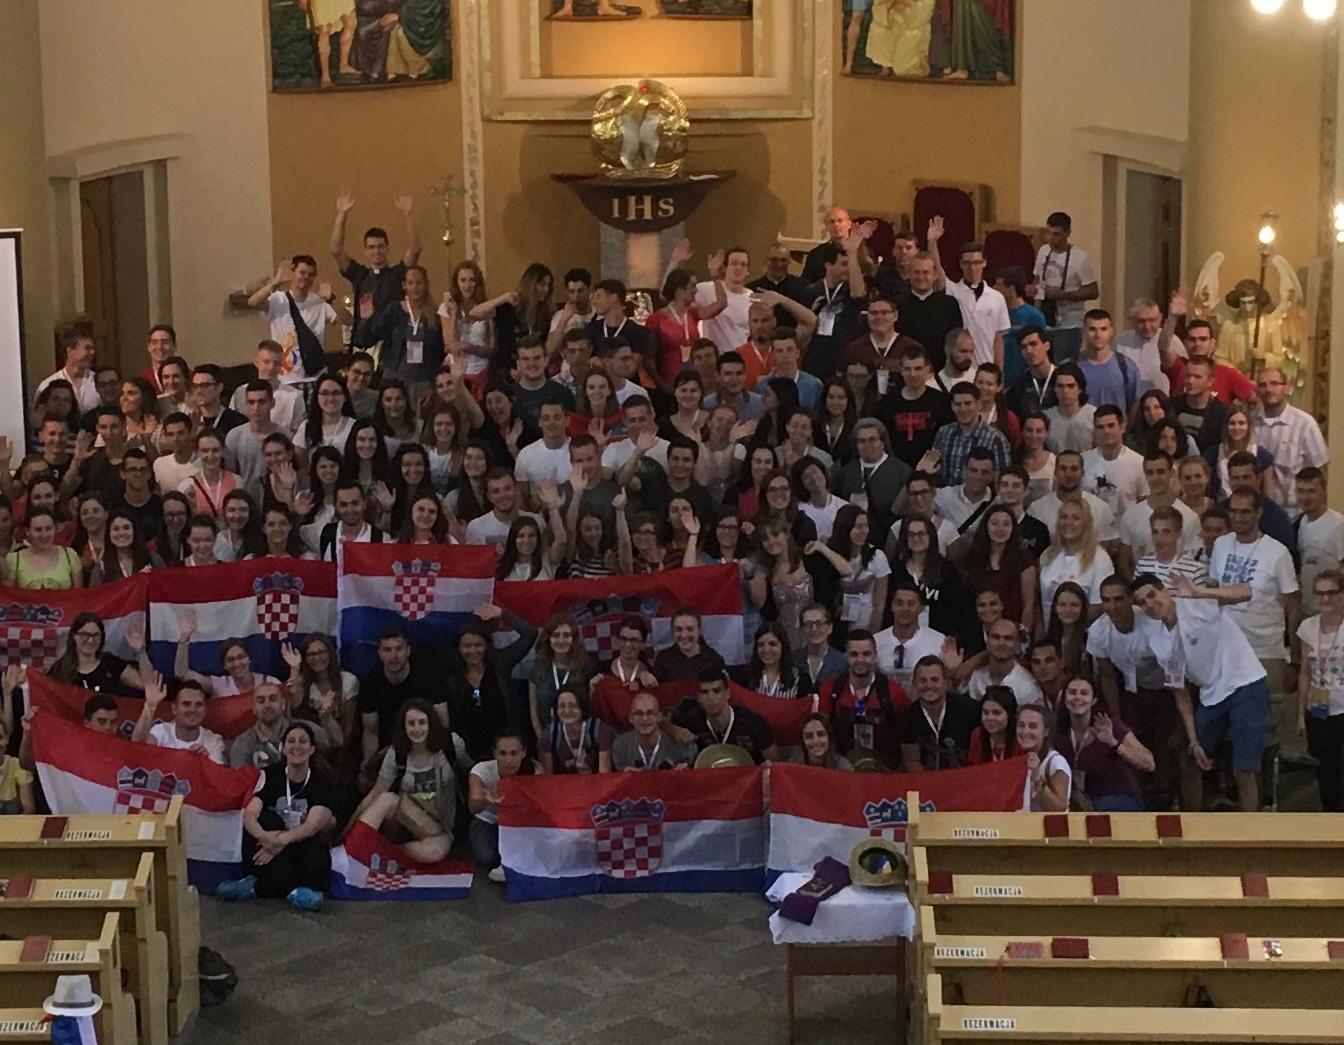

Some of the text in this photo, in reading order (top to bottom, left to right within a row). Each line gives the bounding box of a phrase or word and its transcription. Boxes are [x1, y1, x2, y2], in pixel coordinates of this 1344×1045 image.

[612, 195, 674, 221] IHS
[66, 831, 110, 840] REZERWACJA
[954, 829, 997, 837] REZERWACJA
[55, 890, 100, 899] REZERWACJA
[975, 886, 1022, 895] REZERWACJA
[45, 952, 85, 962] EZERWACJ
[936, 948, 984, 957] REZERWACJA
[963, 1019, 1015, 1029] REZERWACJA
